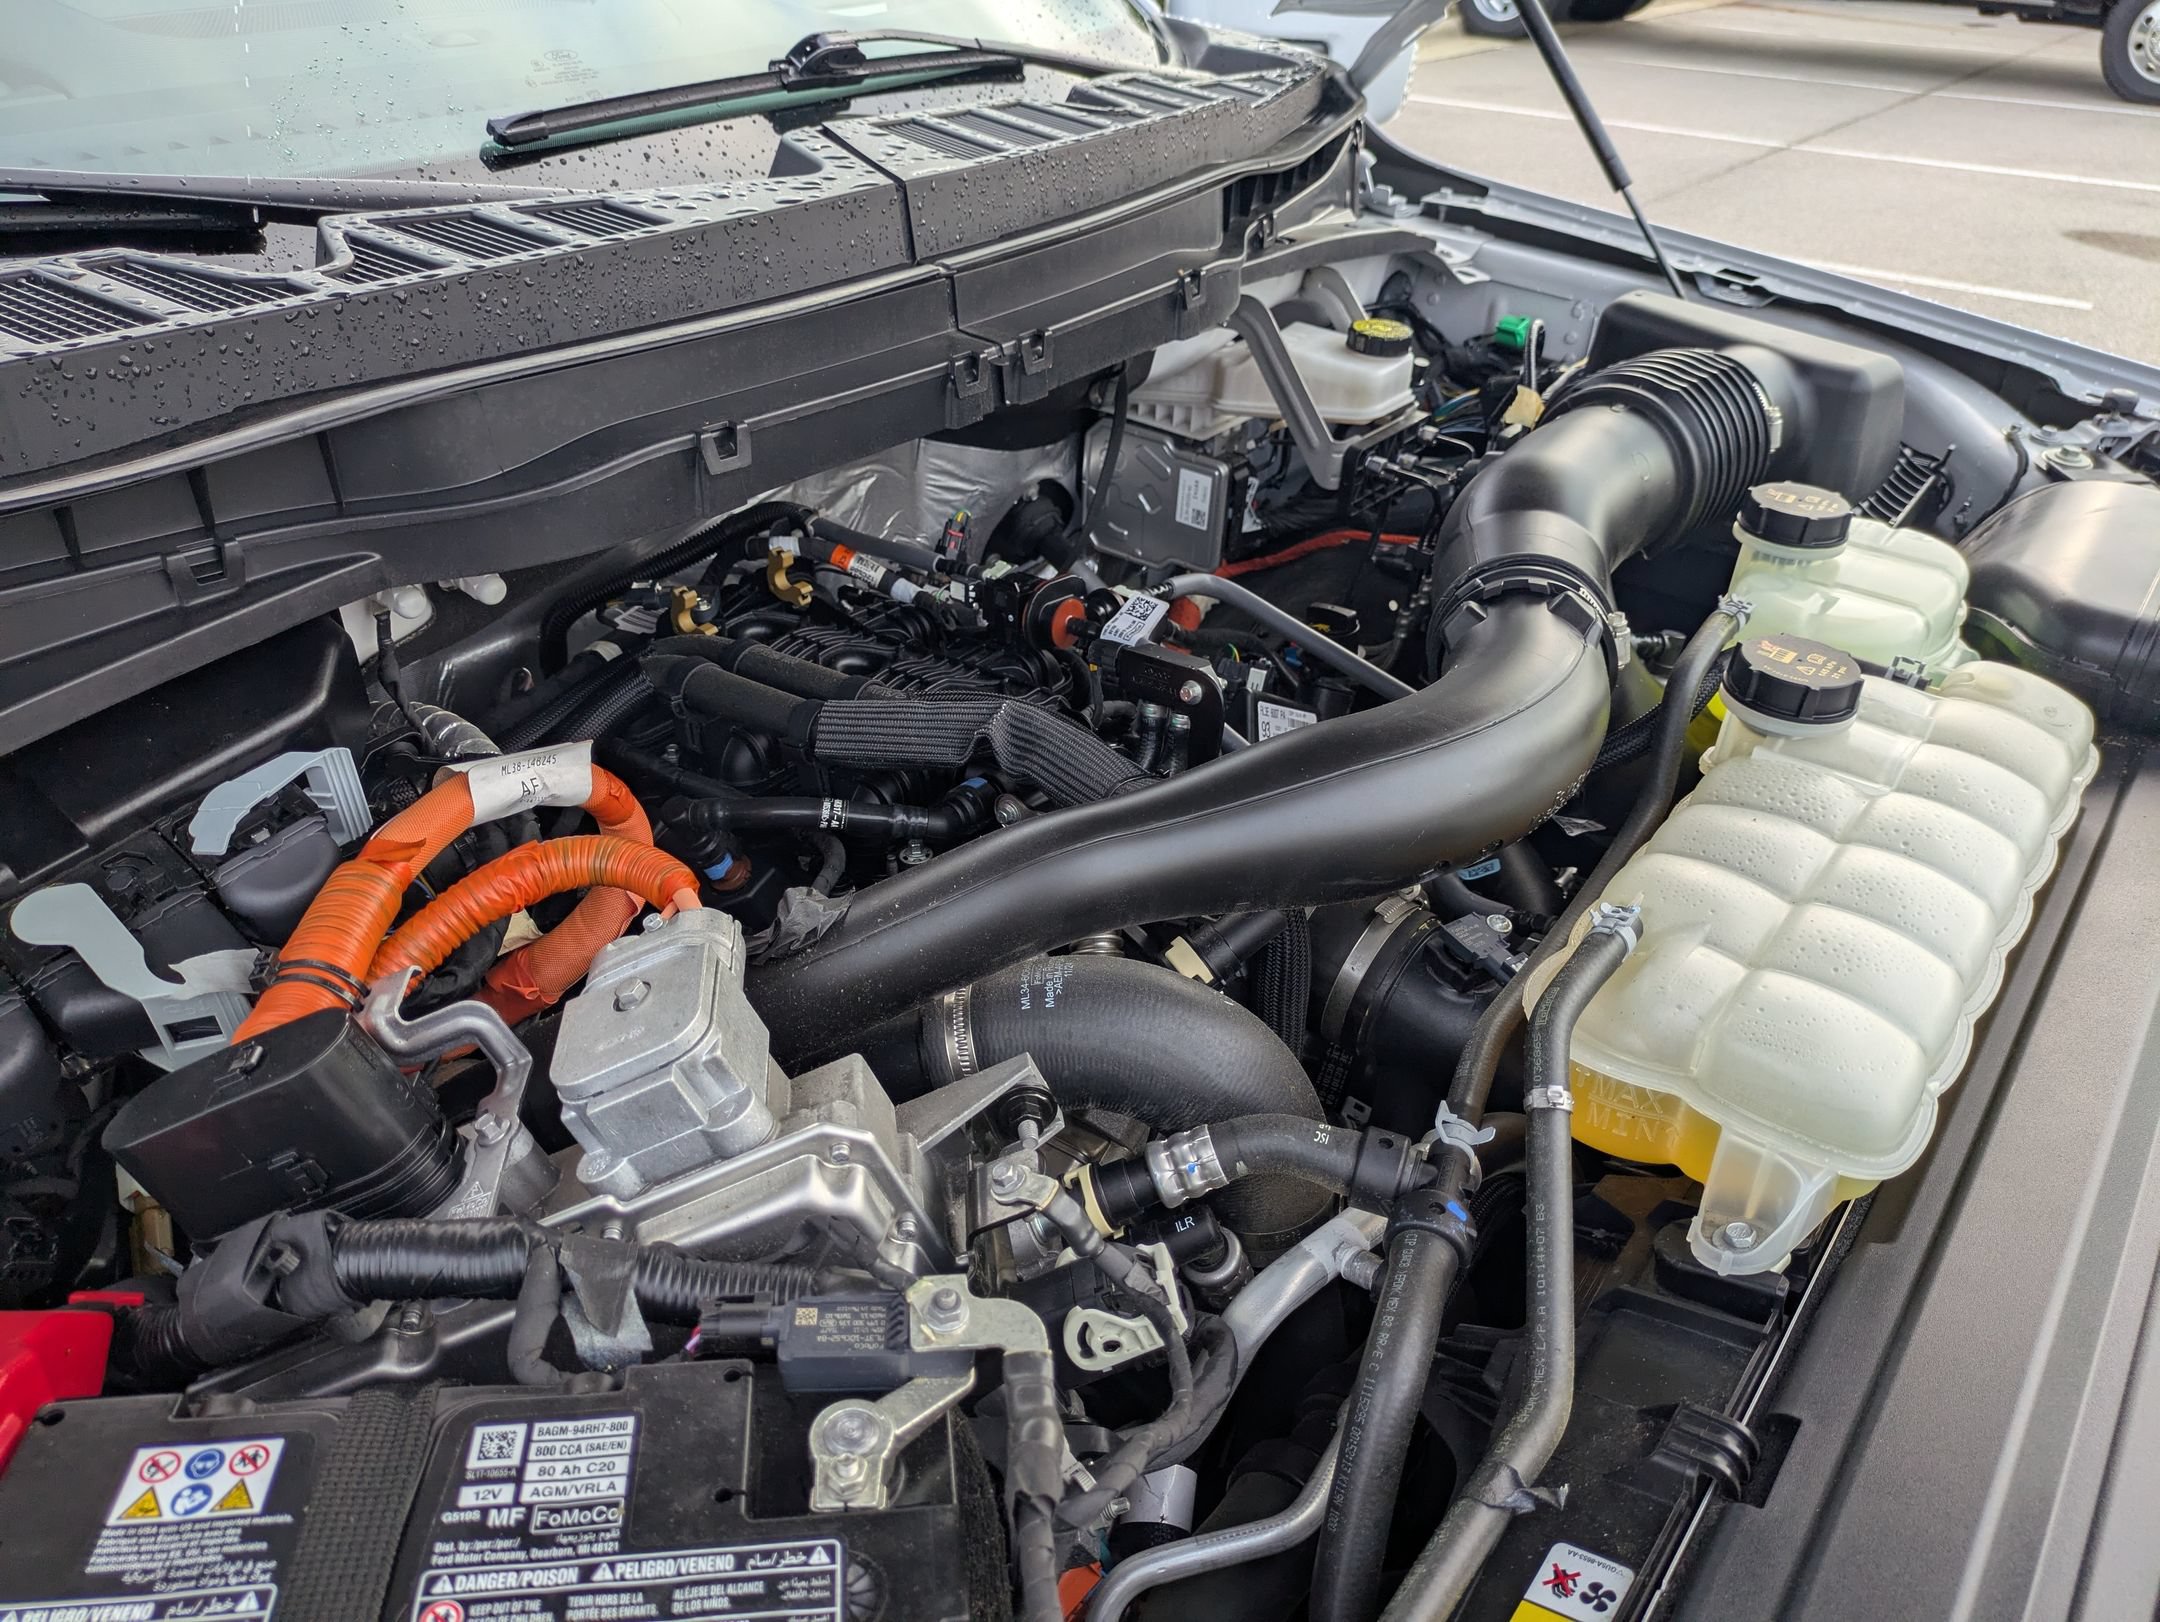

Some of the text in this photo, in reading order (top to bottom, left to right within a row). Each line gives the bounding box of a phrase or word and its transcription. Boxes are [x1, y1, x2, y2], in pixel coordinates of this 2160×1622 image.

[1261, 721, 1271, 738] 93
[521, 777, 540, 797] AF
[1044, 981, 1055, 1008] Made
[1592, 1075, 1664, 1115] MAX
[1586, 1102, 1661, 1143] MIN
[1175, 1216, 1195, 1233] ILR
[1536, 1233, 1546, 1296] 10:14:07
[535, 1440, 627, 1457] 800 CCA (SAE/EN)
[537, 1461, 616, 1477] 80 Ah C20
[474, 1488, 502, 1501] 12V
[530, 1481, 617, 1498] AGM/VRLA
[487, 1507, 526, 1529] MF
[536, 1506, 620, 1528] FoMoCo
[432, 1552, 453, 1566] Ford
[454, 1551, 482, 1564] Motor
[483, 1548, 529, 1563] Company,
[530, 1545, 576, 1559] Dearborn,
[577, 1544, 590, 1555] MI
[434, 1541, 457, 1553] Dist.
[455, 1554, 735, 1592] DANGER/POISON PELIGRO/VENENO
[673, 1581, 764, 1600] ALÉJESE DEL ALCANCE
[469, 1599, 542, 1617] KEEP OUT OF THE
[568, 1592, 644, 1608] TENIR HORS DE LA
[672, 1602, 684, 1614] DE
[684, 1600, 701, 1612] LOS
[565, 1603, 659, 1621] PORTÉE DES ENFANTS.
